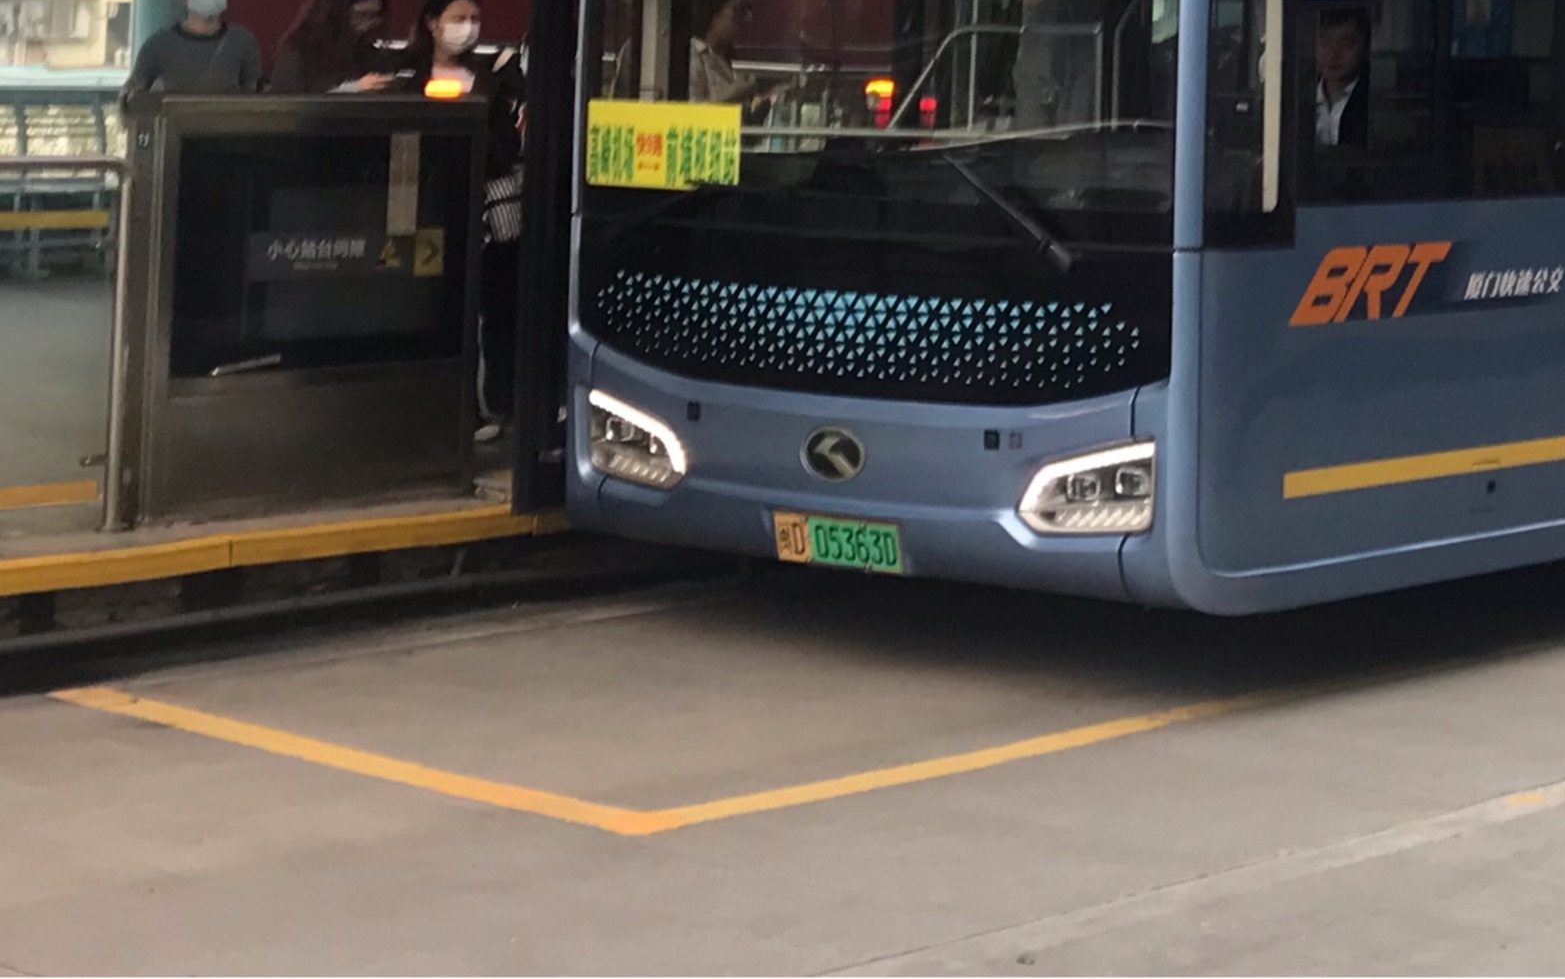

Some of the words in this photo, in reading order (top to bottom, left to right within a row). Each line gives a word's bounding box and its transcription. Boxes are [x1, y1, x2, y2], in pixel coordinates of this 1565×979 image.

[1288, 241, 1453, 327] BRT
[1463, 264, 1565, 300] 厦门快速公交
